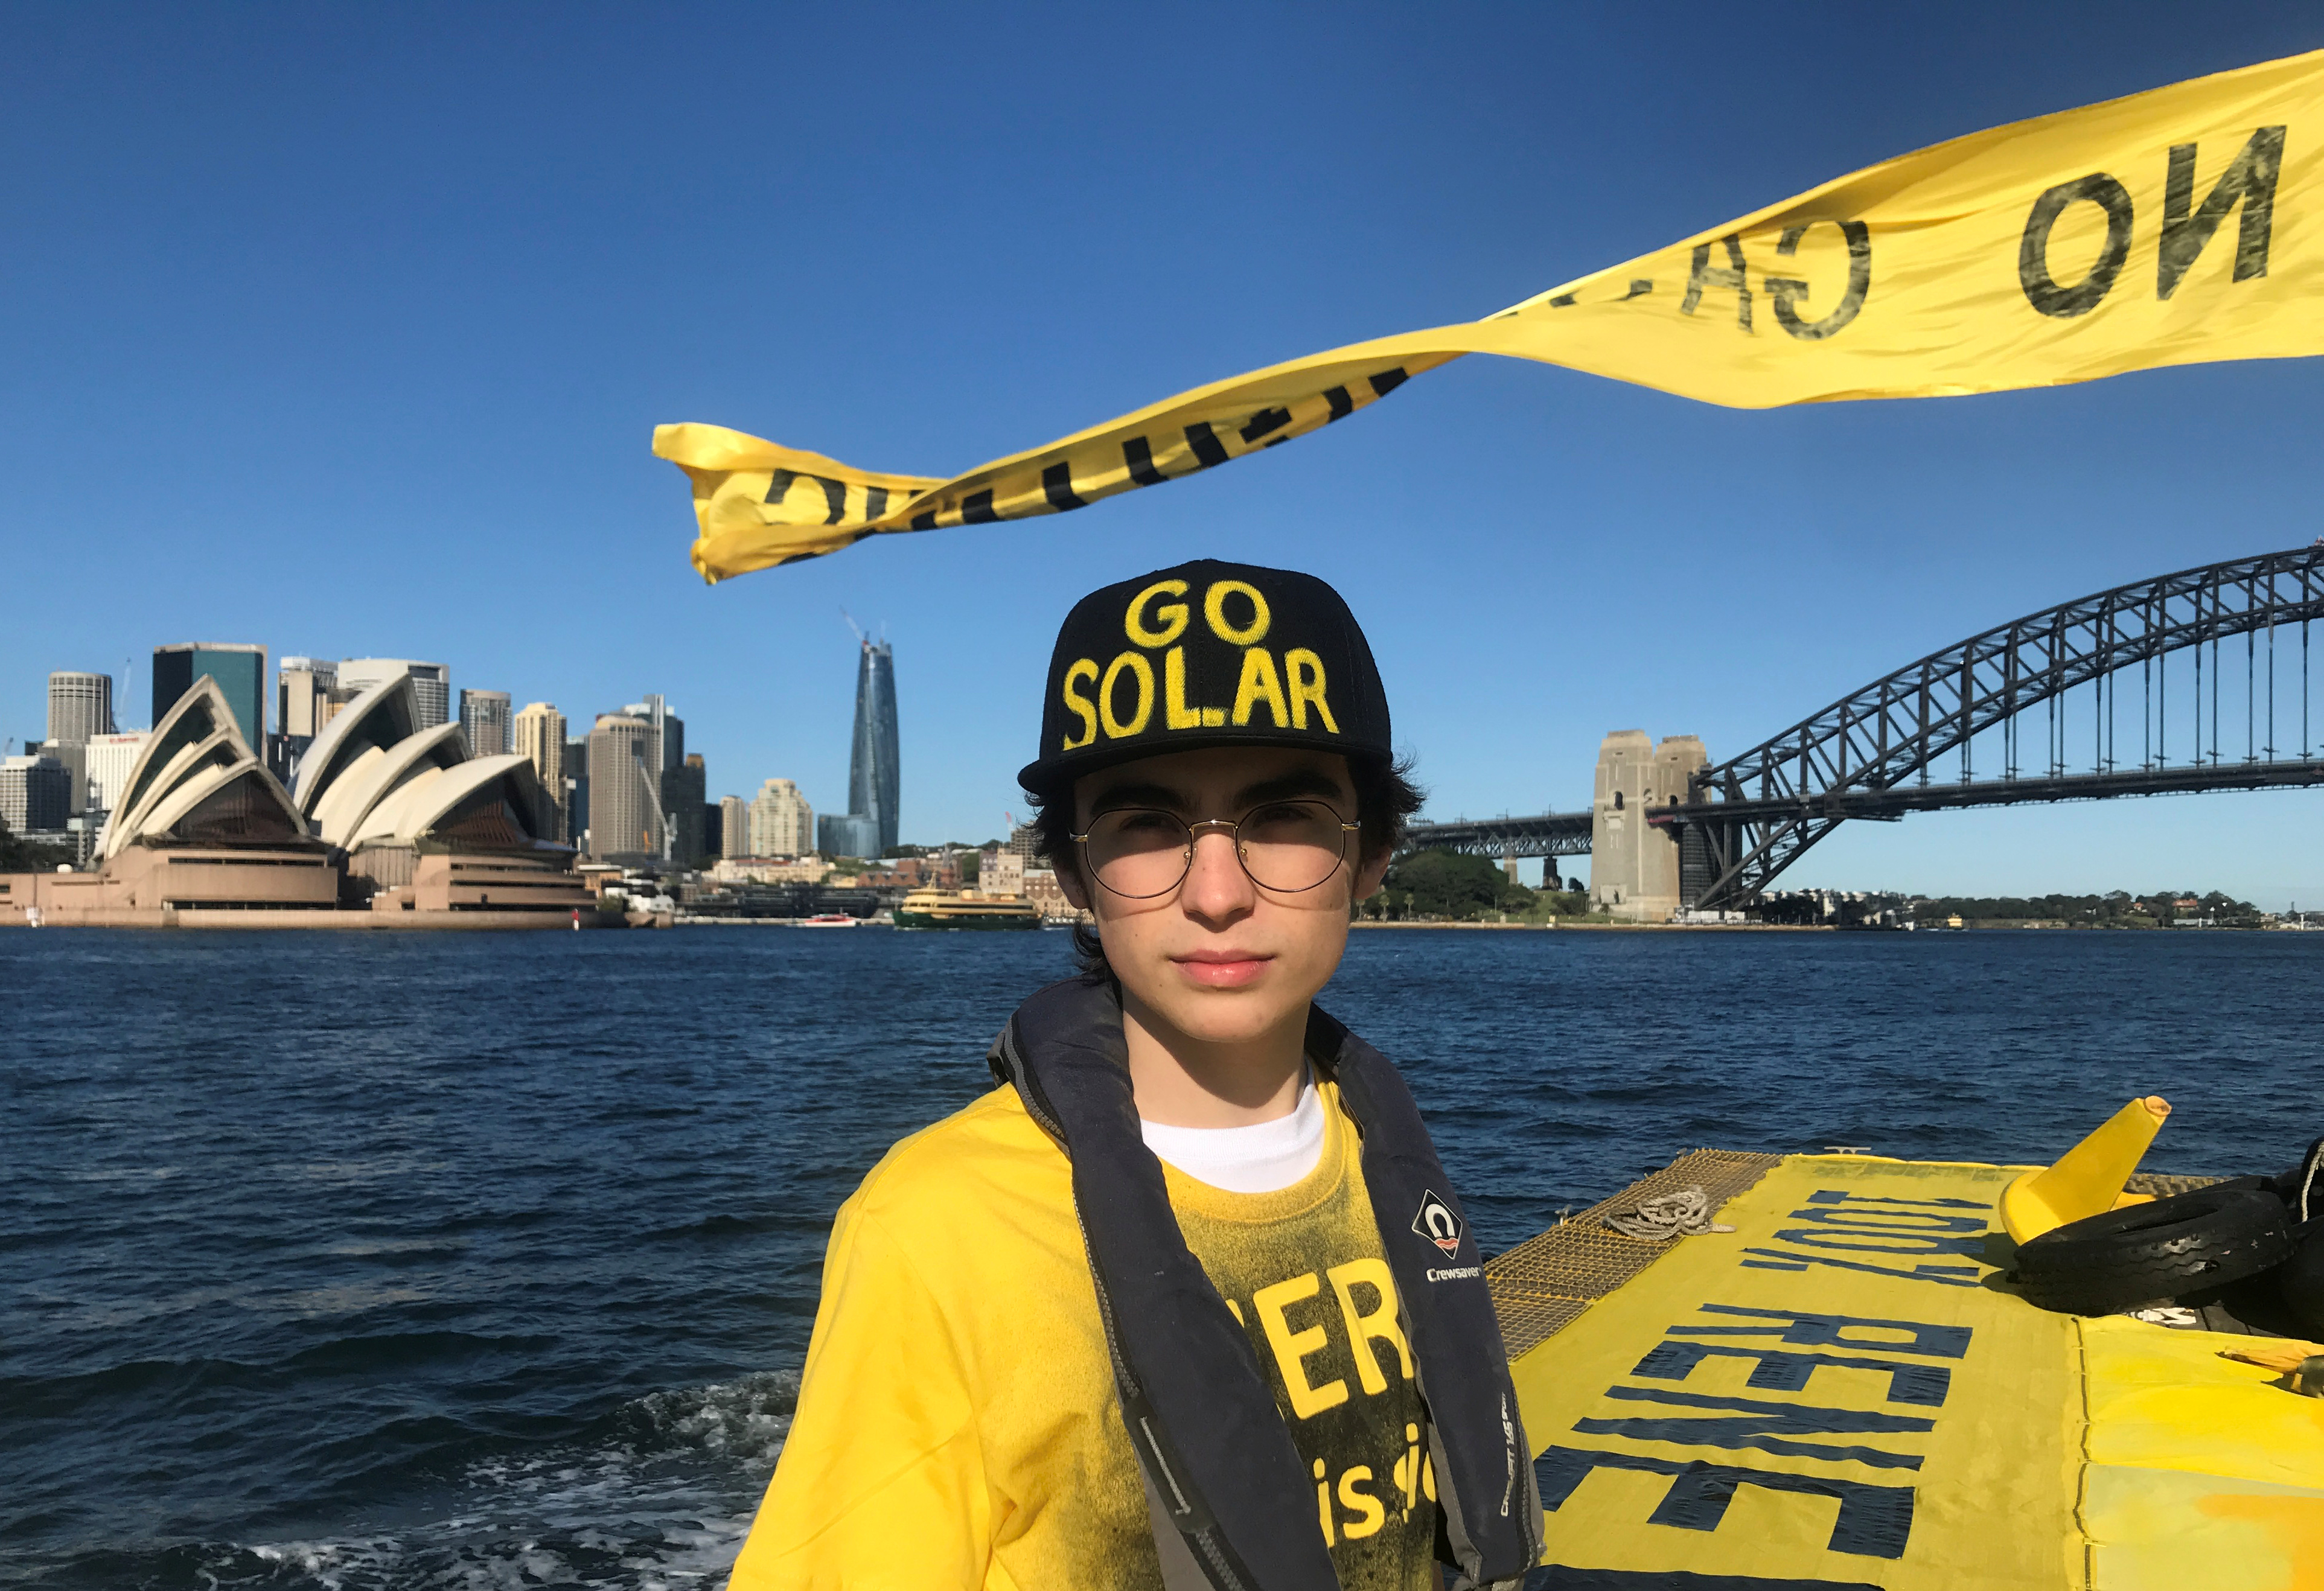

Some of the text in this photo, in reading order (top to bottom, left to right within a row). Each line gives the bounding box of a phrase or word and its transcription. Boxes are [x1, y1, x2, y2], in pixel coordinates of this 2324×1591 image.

[1125, 579, 1272, 648] GO
[1063, 645, 1340, 751] SOLAR
[1426, 1266, 1480, 1283] Crewsaver
[1225, 1258, 1414, 1420] ER
[1524, 1189, 1994, 1591] 100% RENE
